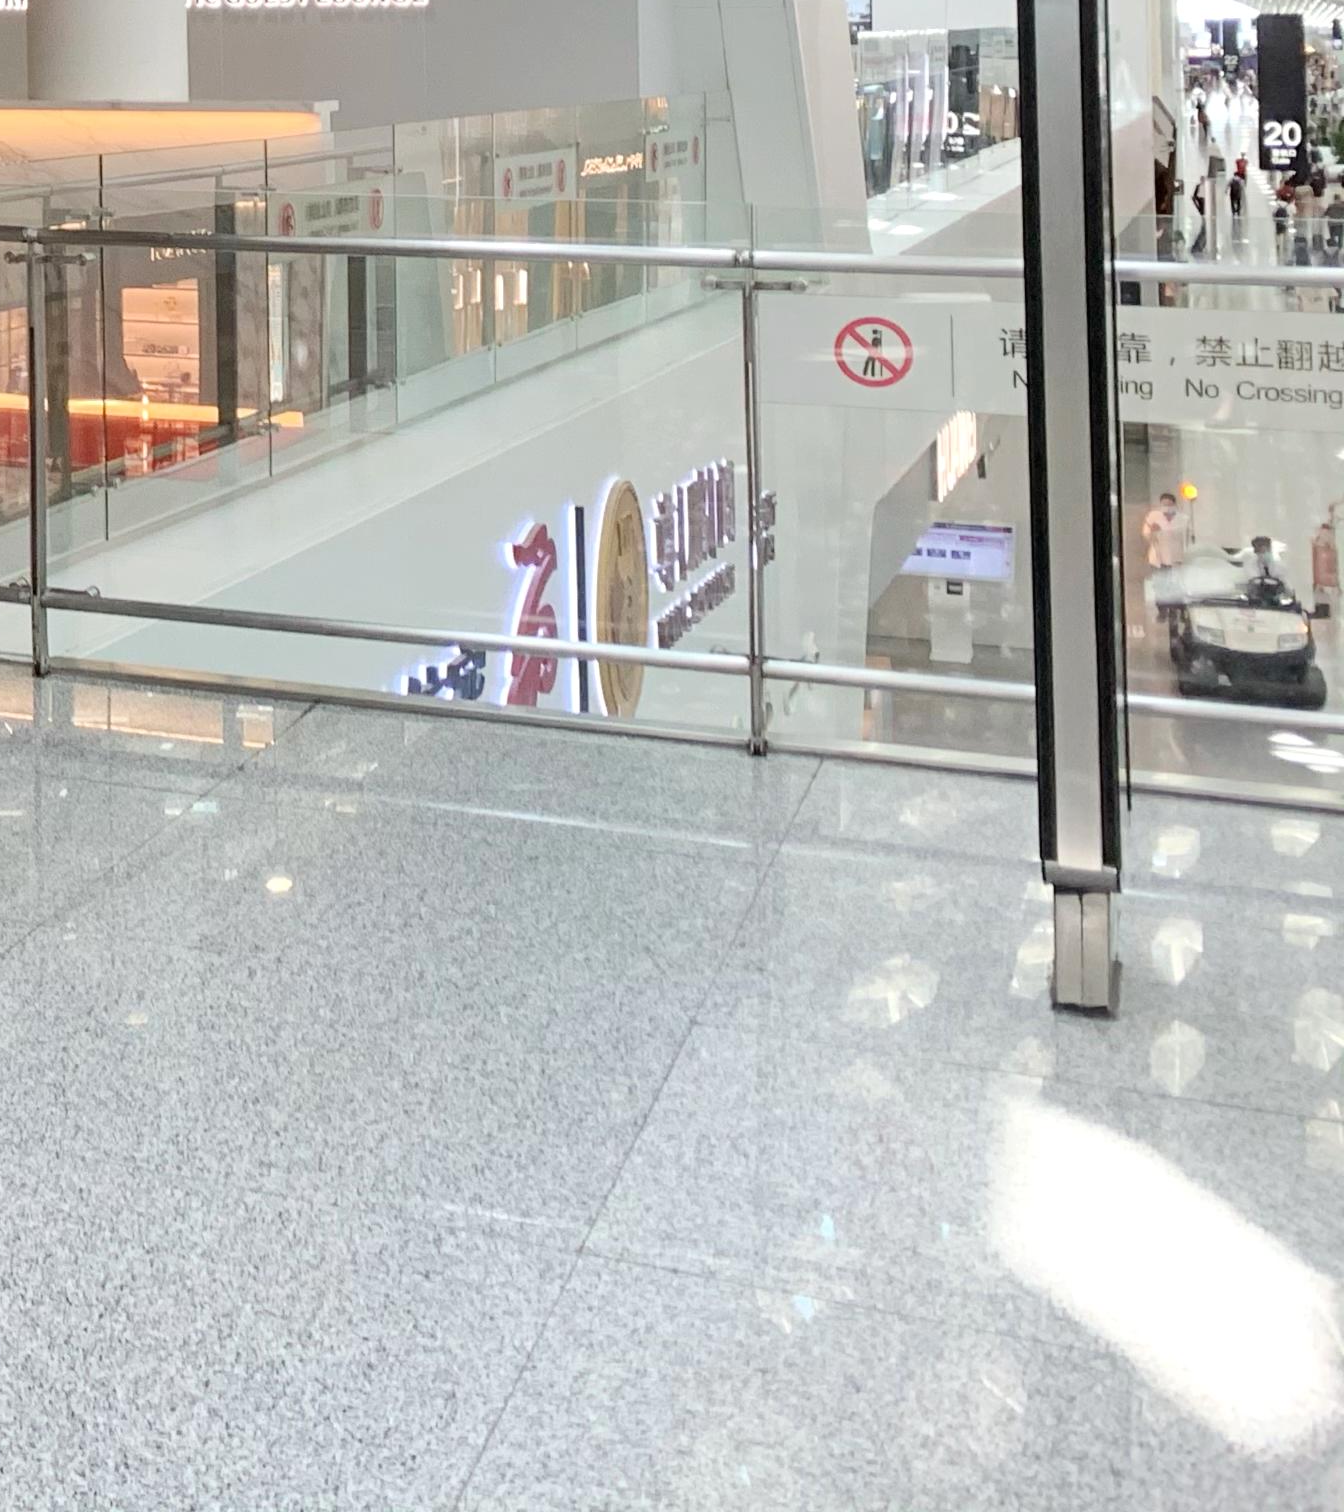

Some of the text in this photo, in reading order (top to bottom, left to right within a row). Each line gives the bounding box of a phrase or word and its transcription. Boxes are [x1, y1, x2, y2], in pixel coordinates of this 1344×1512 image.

[1263, 120, 1302, 147] 20
[1186, 378, 1344, 410] No Crossing
